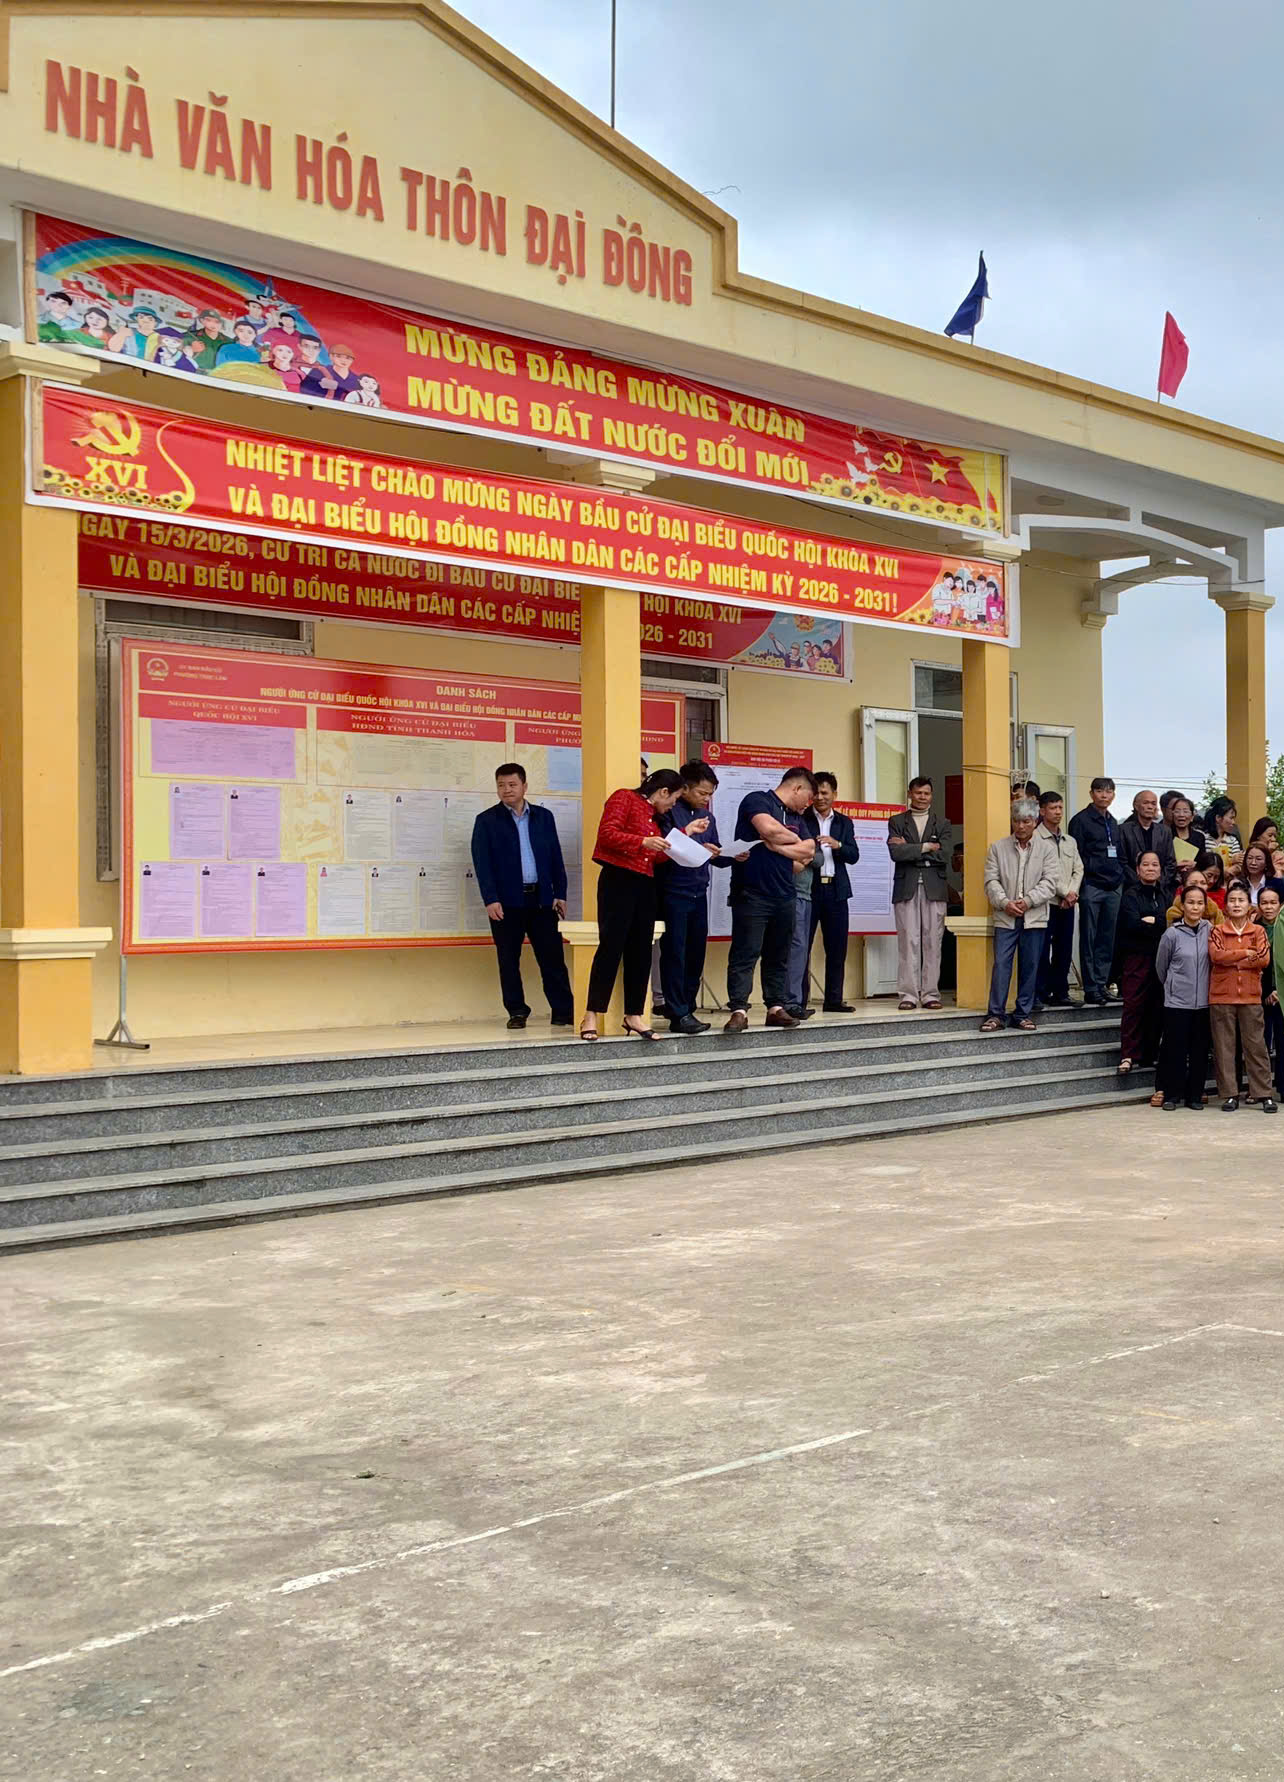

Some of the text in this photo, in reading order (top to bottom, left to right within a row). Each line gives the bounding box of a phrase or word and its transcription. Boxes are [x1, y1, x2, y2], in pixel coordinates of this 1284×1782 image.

[45, 58, 154, 159] NHÀ
[174, 91, 272, 191] VĂN
[296, 131, 384, 222] HÓA
[400, 167, 507, 257] THÔN
[603, 214, 692, 306] ĐỒNG
[404, 323, 805, 443] MỪNG ĐẢNG MỪNG XUÂN
[407, 376, 809, 486] MỪNG ĐẤT NƯỚC ĐỔI MỚI
[84, 456, 148, 489] XVI
[226, 439, 305, 481] NHIỆT
[312, 455, 364, 492] LIỆT
[371, 465, 435, 500] CHÀO
[443, 477, 510, 513] MỪNG
[517, 491, 574, 523] NGÀY
[580, 497, 620, 531] BẦU
[626, 505, 654, 537] CỬ
[657, 515, 689, 546] ĐẠI
[695, 518, 737, 551] BIỂU
[742, 529, 789, 560] QUỐC
[794, 538, 822, 569] HỘI
[874, 555, 899, 579] XVI
[109, 552, 141, 579] VÀ
[147, 559, 187, 588] ĐẠI
[193, 561, 245, 591] BIỂU
[251, 571, 287, 600] HỘI
[293, 573, 350, 605] ĐỒNG
[356, 586, 411, 612] NHÂN
[417, 592, 455, 617] DÂN
[460, 597, 497, 622] CÁC
[502, 599, 536, 626] CẤP
[541, 609, 581, 636] NHIỆ
[678, 628, 713, 649] 2031
[137, 522, 255, 560] 15/3/2026,
[296, 543, 328, 568] TRI
[425, 561, 444, 583] ĐI
[520, 576, 549, 600] ĐẠI
[718, 605, 742, 625] XVI
[228, 484, 264, 518] VÀ
[271, 493, 316, 529] ĐẠI
[324, 497, 382, 535] BIỂU
[389, 510, 429, 546] HỘI
[435, 514, 498, 553] ĐỒNG
[505, 530, 566, 563] NHÂN
[572, 538, 614, 570] DÂN
[620, 546, 659, 577] CÁC
[665, 551, 703, 582] CẤP
[708, 562, 767, 595] NHIỆM
[772, 570, 794, 598] KỲ
[799, 577, 839, 604] 2026
[854, 587, 898, 613] 2031!
[415, 700, 428, 710] XVI
[436, 685, 497, 700] DANH SÁCH
